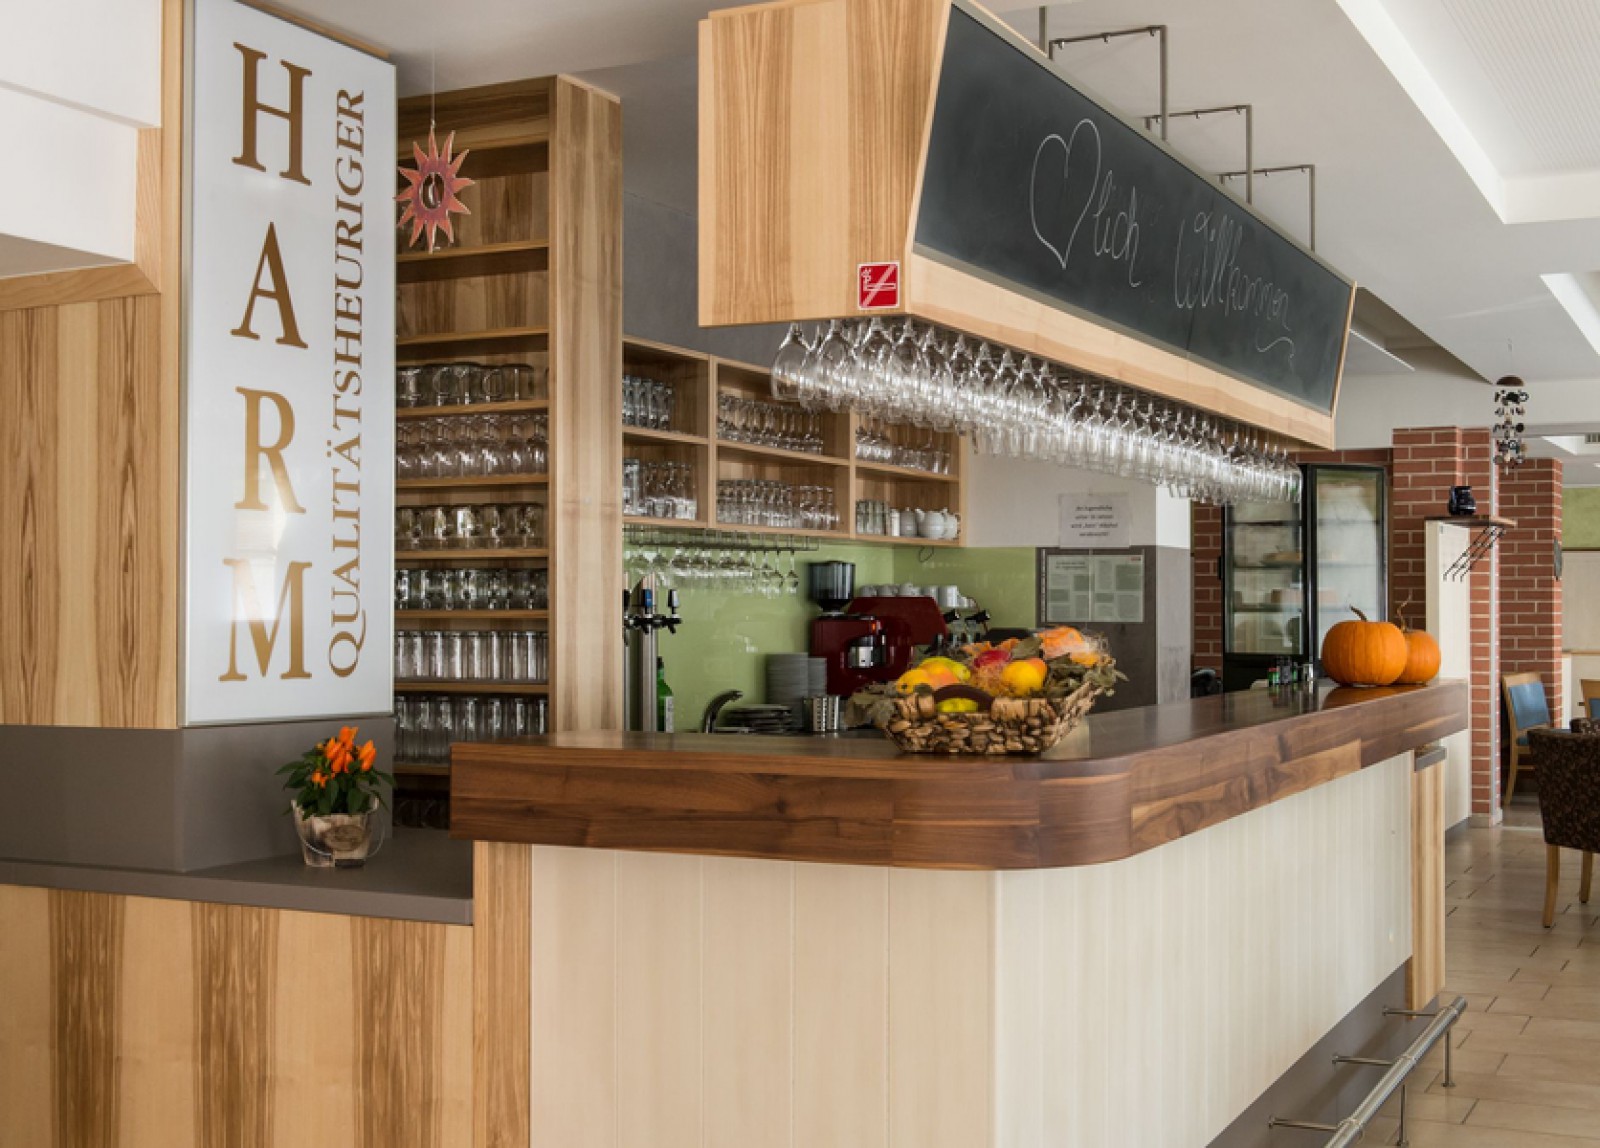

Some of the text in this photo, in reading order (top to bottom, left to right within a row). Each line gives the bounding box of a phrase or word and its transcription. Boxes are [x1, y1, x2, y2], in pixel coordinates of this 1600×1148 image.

[218, 41, 313, 682] HARM
[327, 89, 367, 678] QUALITÄTSHEURIGER
[1174, 211, 1291, 332] Willkommen
